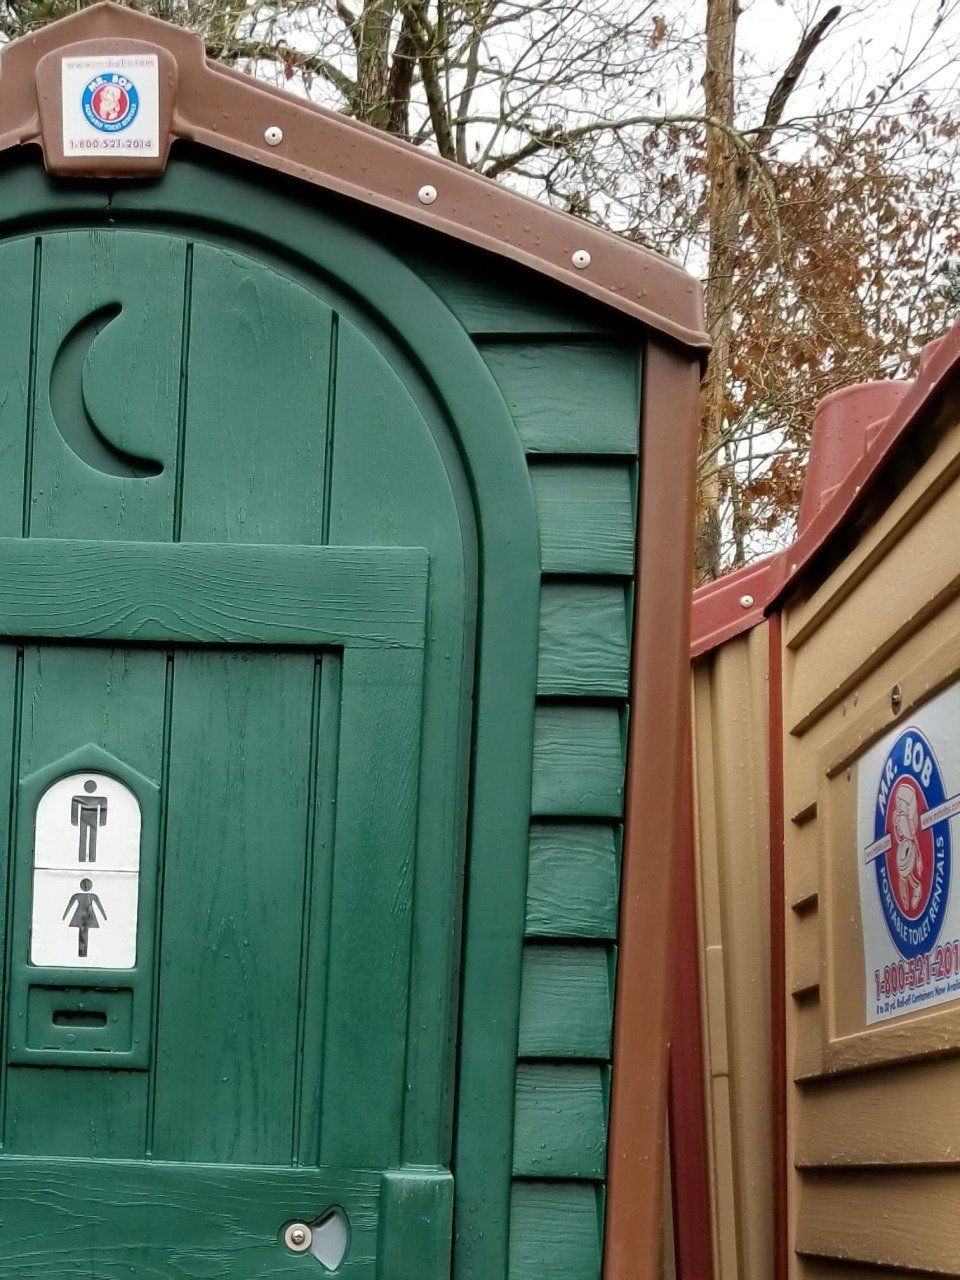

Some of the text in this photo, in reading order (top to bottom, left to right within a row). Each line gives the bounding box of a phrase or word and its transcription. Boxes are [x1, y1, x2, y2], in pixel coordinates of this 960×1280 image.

[879, 737, 933, 817] MR. BOB
[881, 836, 945, 945] PORTABLE TOILET RENTALS
